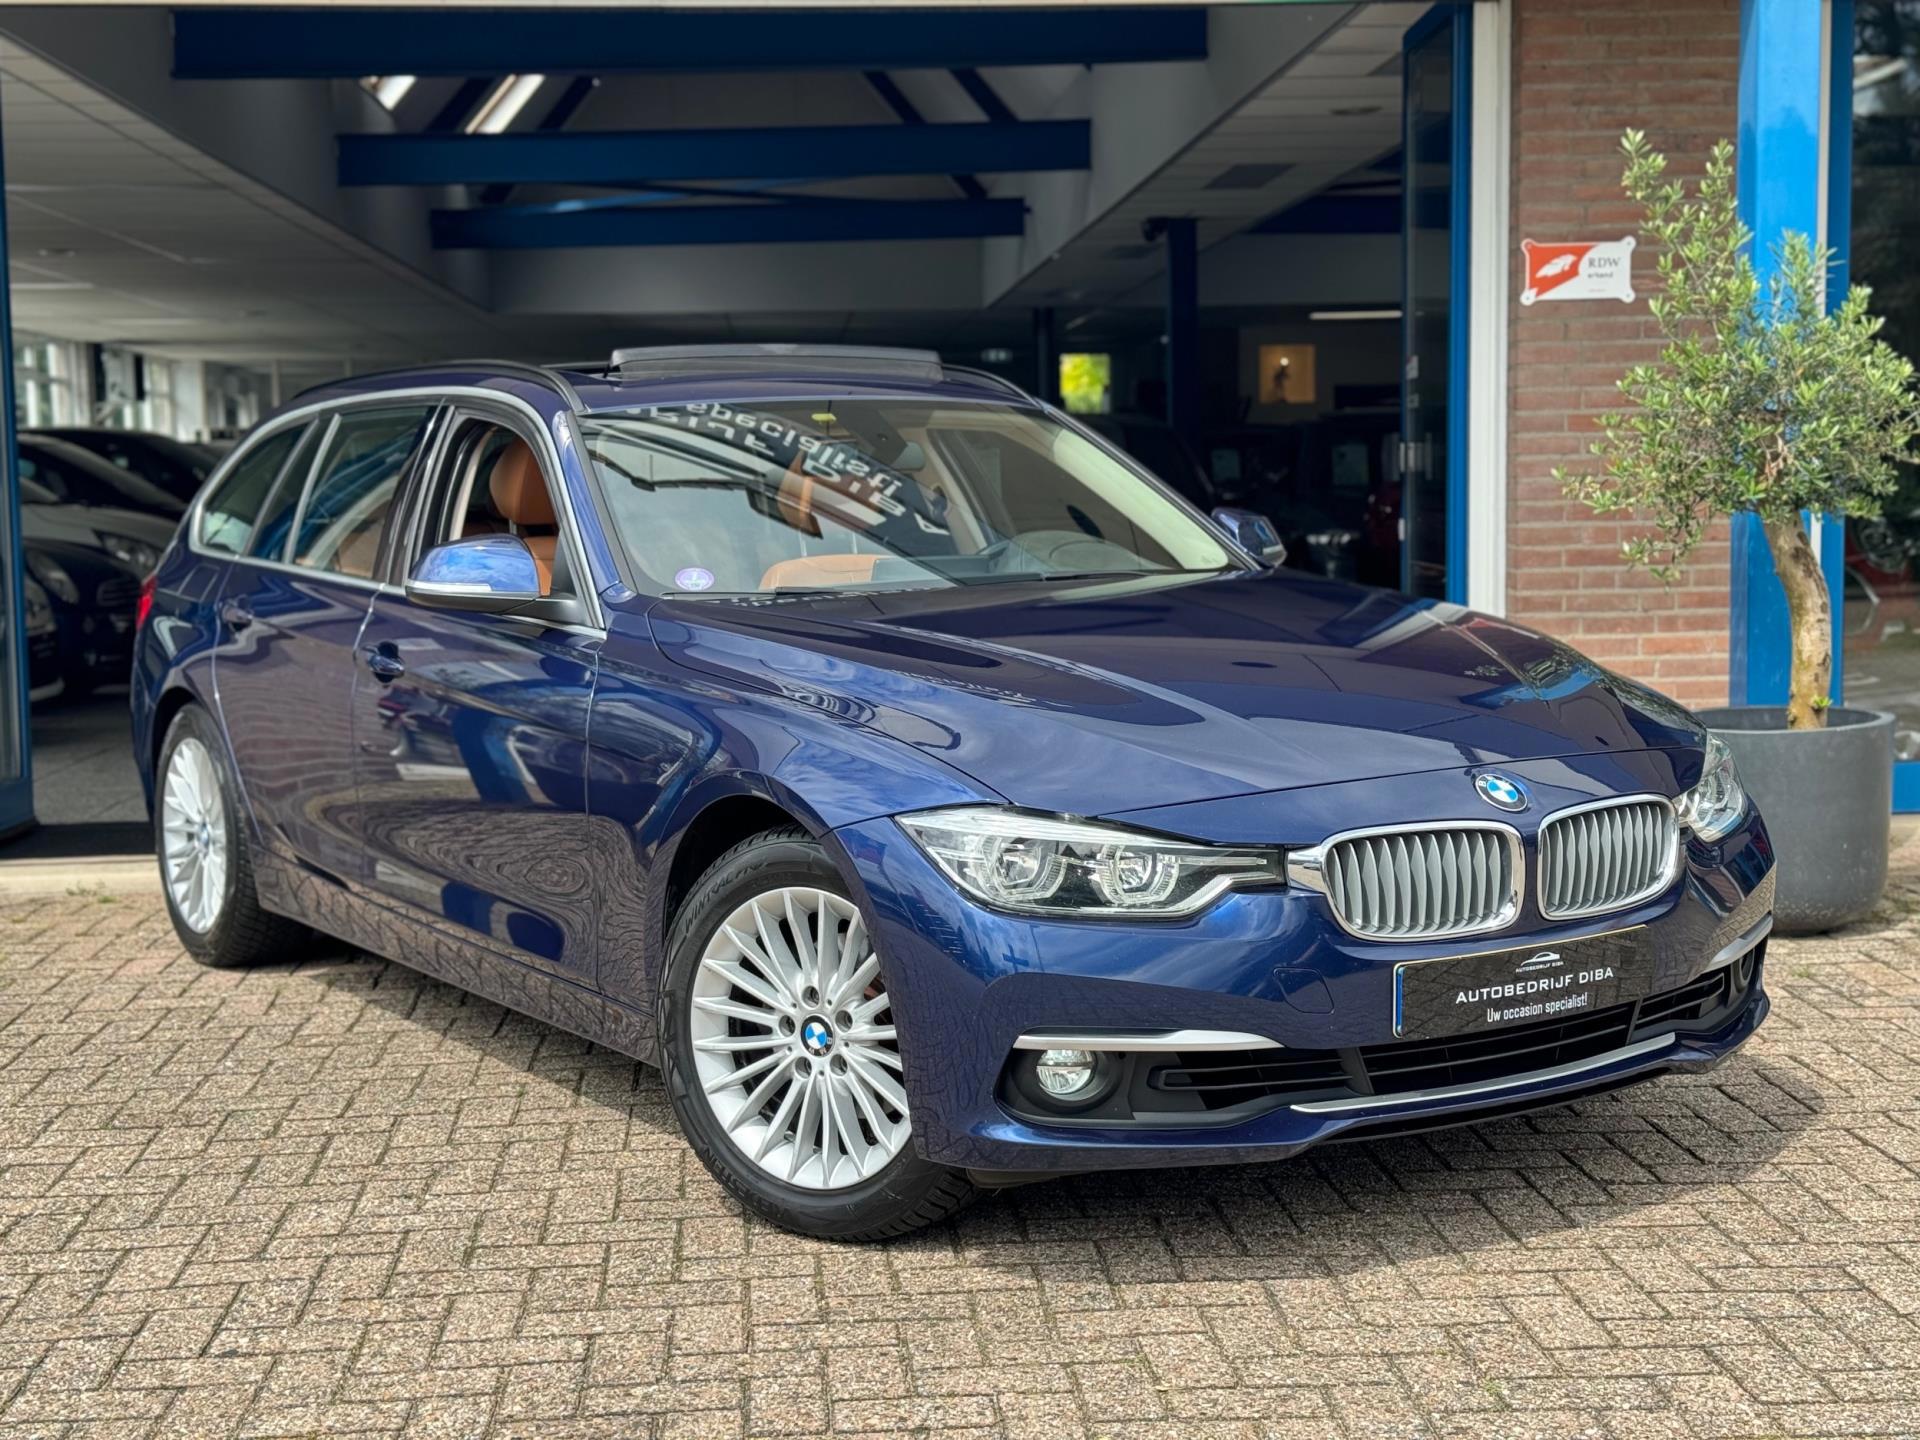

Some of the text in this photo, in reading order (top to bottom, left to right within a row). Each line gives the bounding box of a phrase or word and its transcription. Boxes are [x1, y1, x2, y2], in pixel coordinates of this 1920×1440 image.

[1588, 257, 1621, 268] RDW
[1455, 966, 1614, 1004] AUTOBEDRIJF DIBA
[1487, 992, 1588, 1023] Uw occasion specialist!
